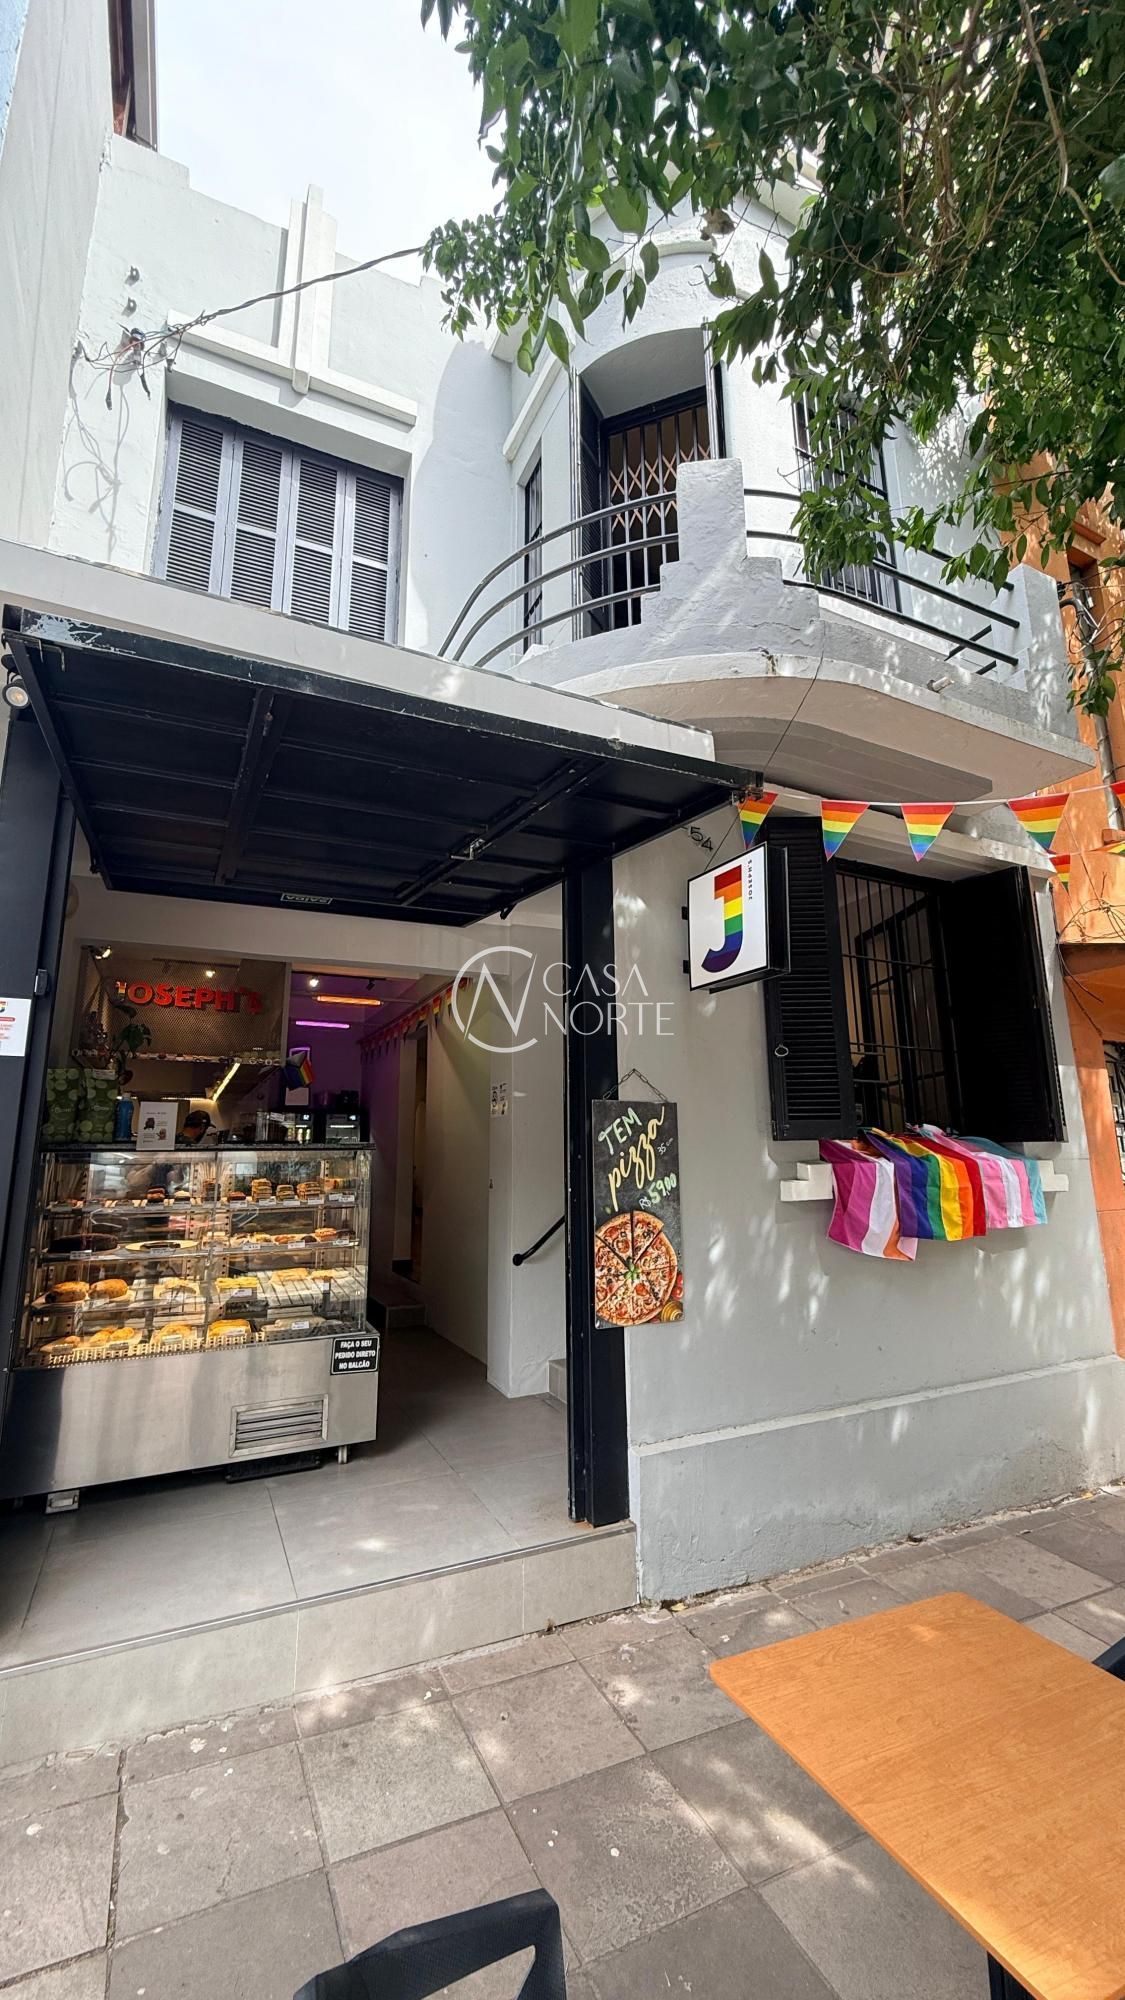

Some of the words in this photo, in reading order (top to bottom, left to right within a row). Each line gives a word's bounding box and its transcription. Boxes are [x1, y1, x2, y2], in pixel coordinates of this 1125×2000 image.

[680, 826, 713, 852] 54
[701, 864, 743, 973] J
[598, 1107, 642, 1155] TEM
[608, 1106, 665, 1212] pizza
[335, 1351, 355, 1359] PEDIDO
[356, 1350, 376, 1358] DIRETO
[340, 1341, 355, 1349] FAÇA
[355, 1340, 360, 1348] O
[361, 1339, 373, 1347] SEU
[338, 1362, 348, 1370] NO
[348, 1360, 370, 1369] BALCÃO
